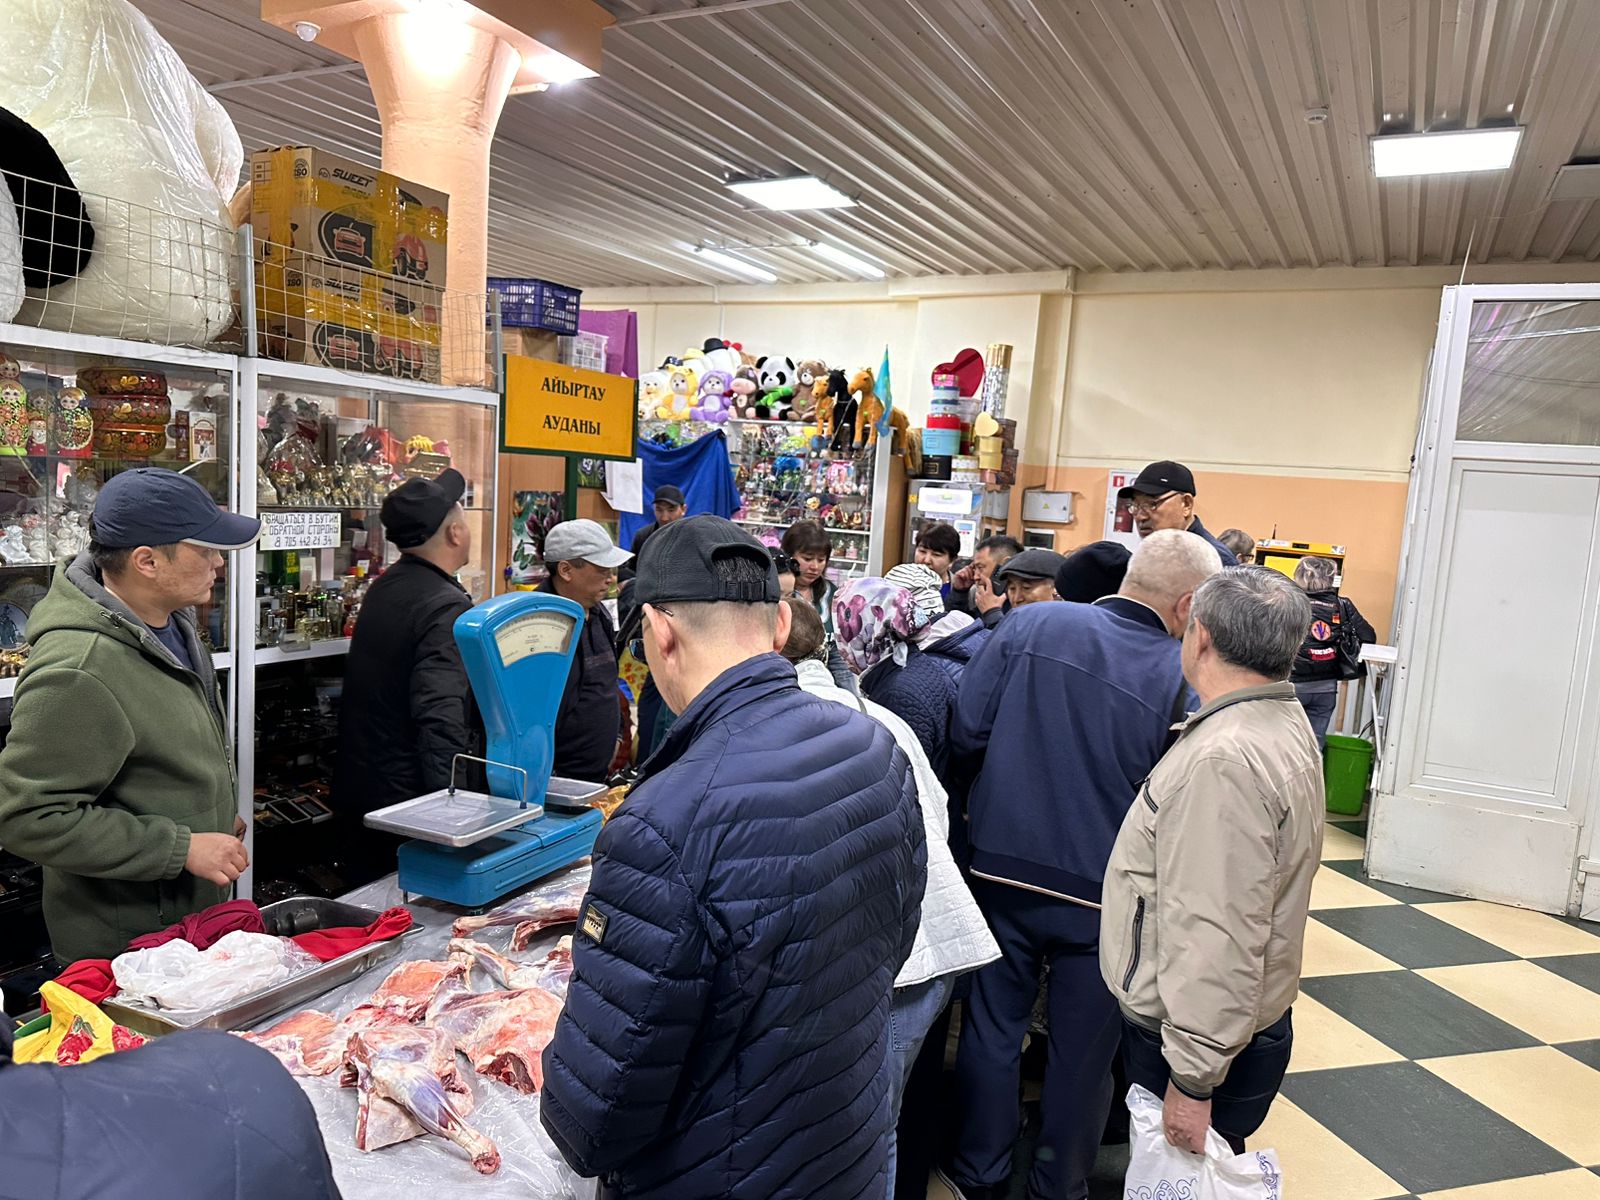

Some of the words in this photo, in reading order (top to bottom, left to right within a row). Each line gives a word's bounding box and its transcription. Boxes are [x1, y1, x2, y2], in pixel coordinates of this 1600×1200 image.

[332, 168, 373, 187] SWEET
[287, 278, 301, 287] ISO
[541, 376, 606, 401] АЙЫРТАУ
[542, 414, 601, 435] АУДАНЫ
[308, 524, 338, 534] СТОРОНЫ
